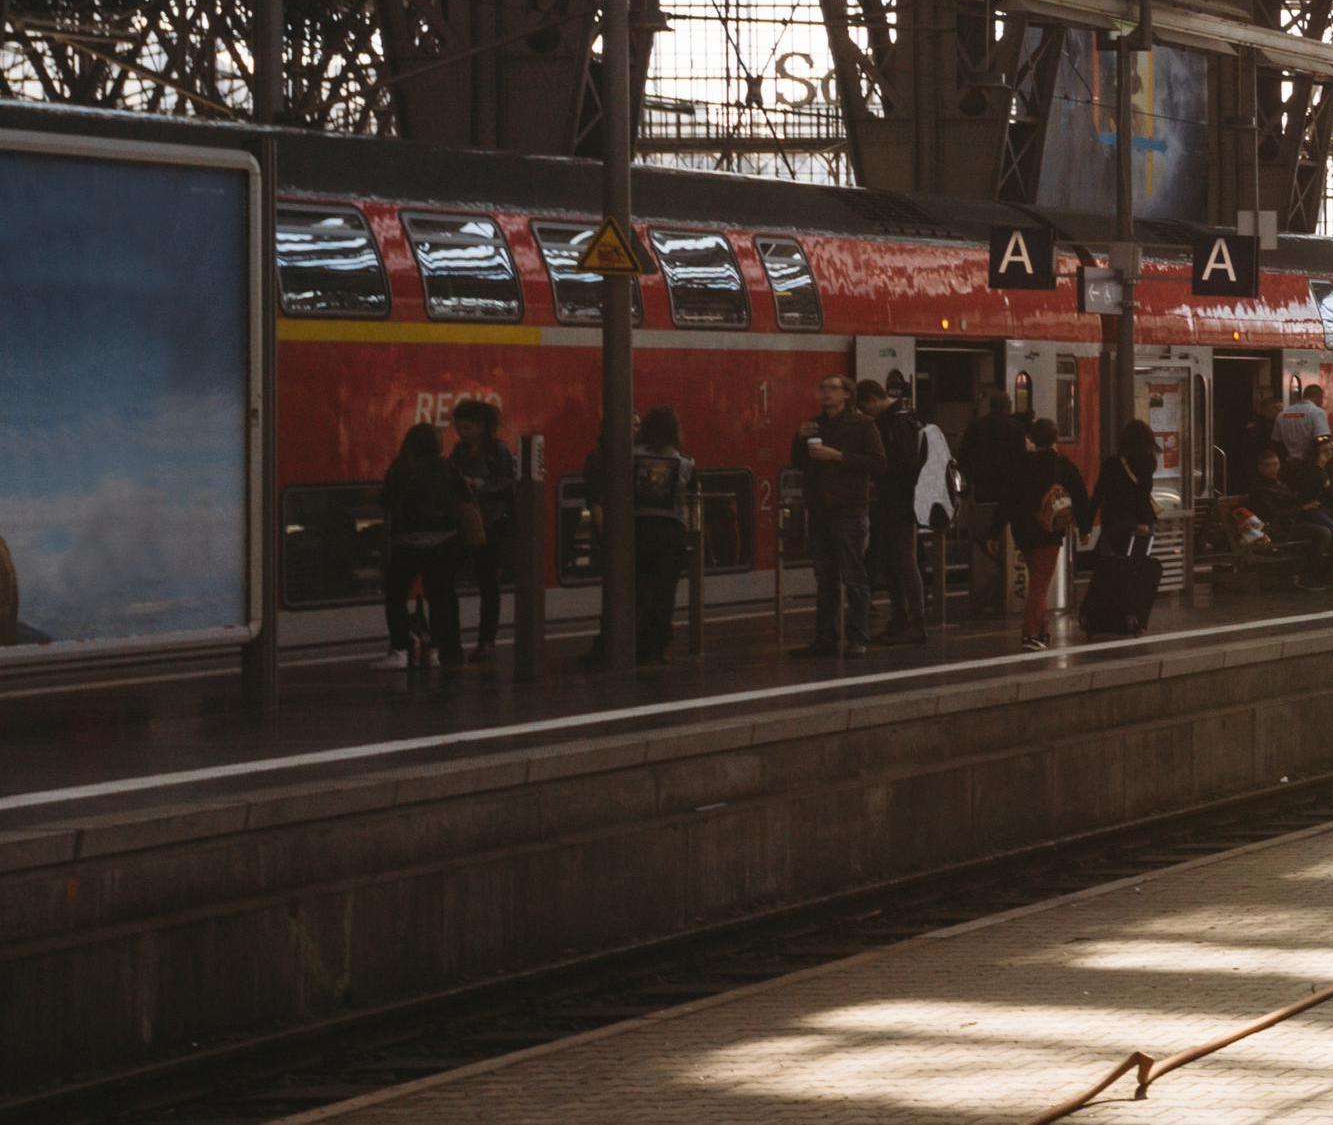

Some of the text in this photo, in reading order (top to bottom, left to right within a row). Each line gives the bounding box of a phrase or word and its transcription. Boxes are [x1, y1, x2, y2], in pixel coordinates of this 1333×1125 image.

[998, 230, 1034, 274] A
[1201, 238, 1237, 282] A
[759, 380, 769, 415] 1
[759, 479, 772, 511] 2
